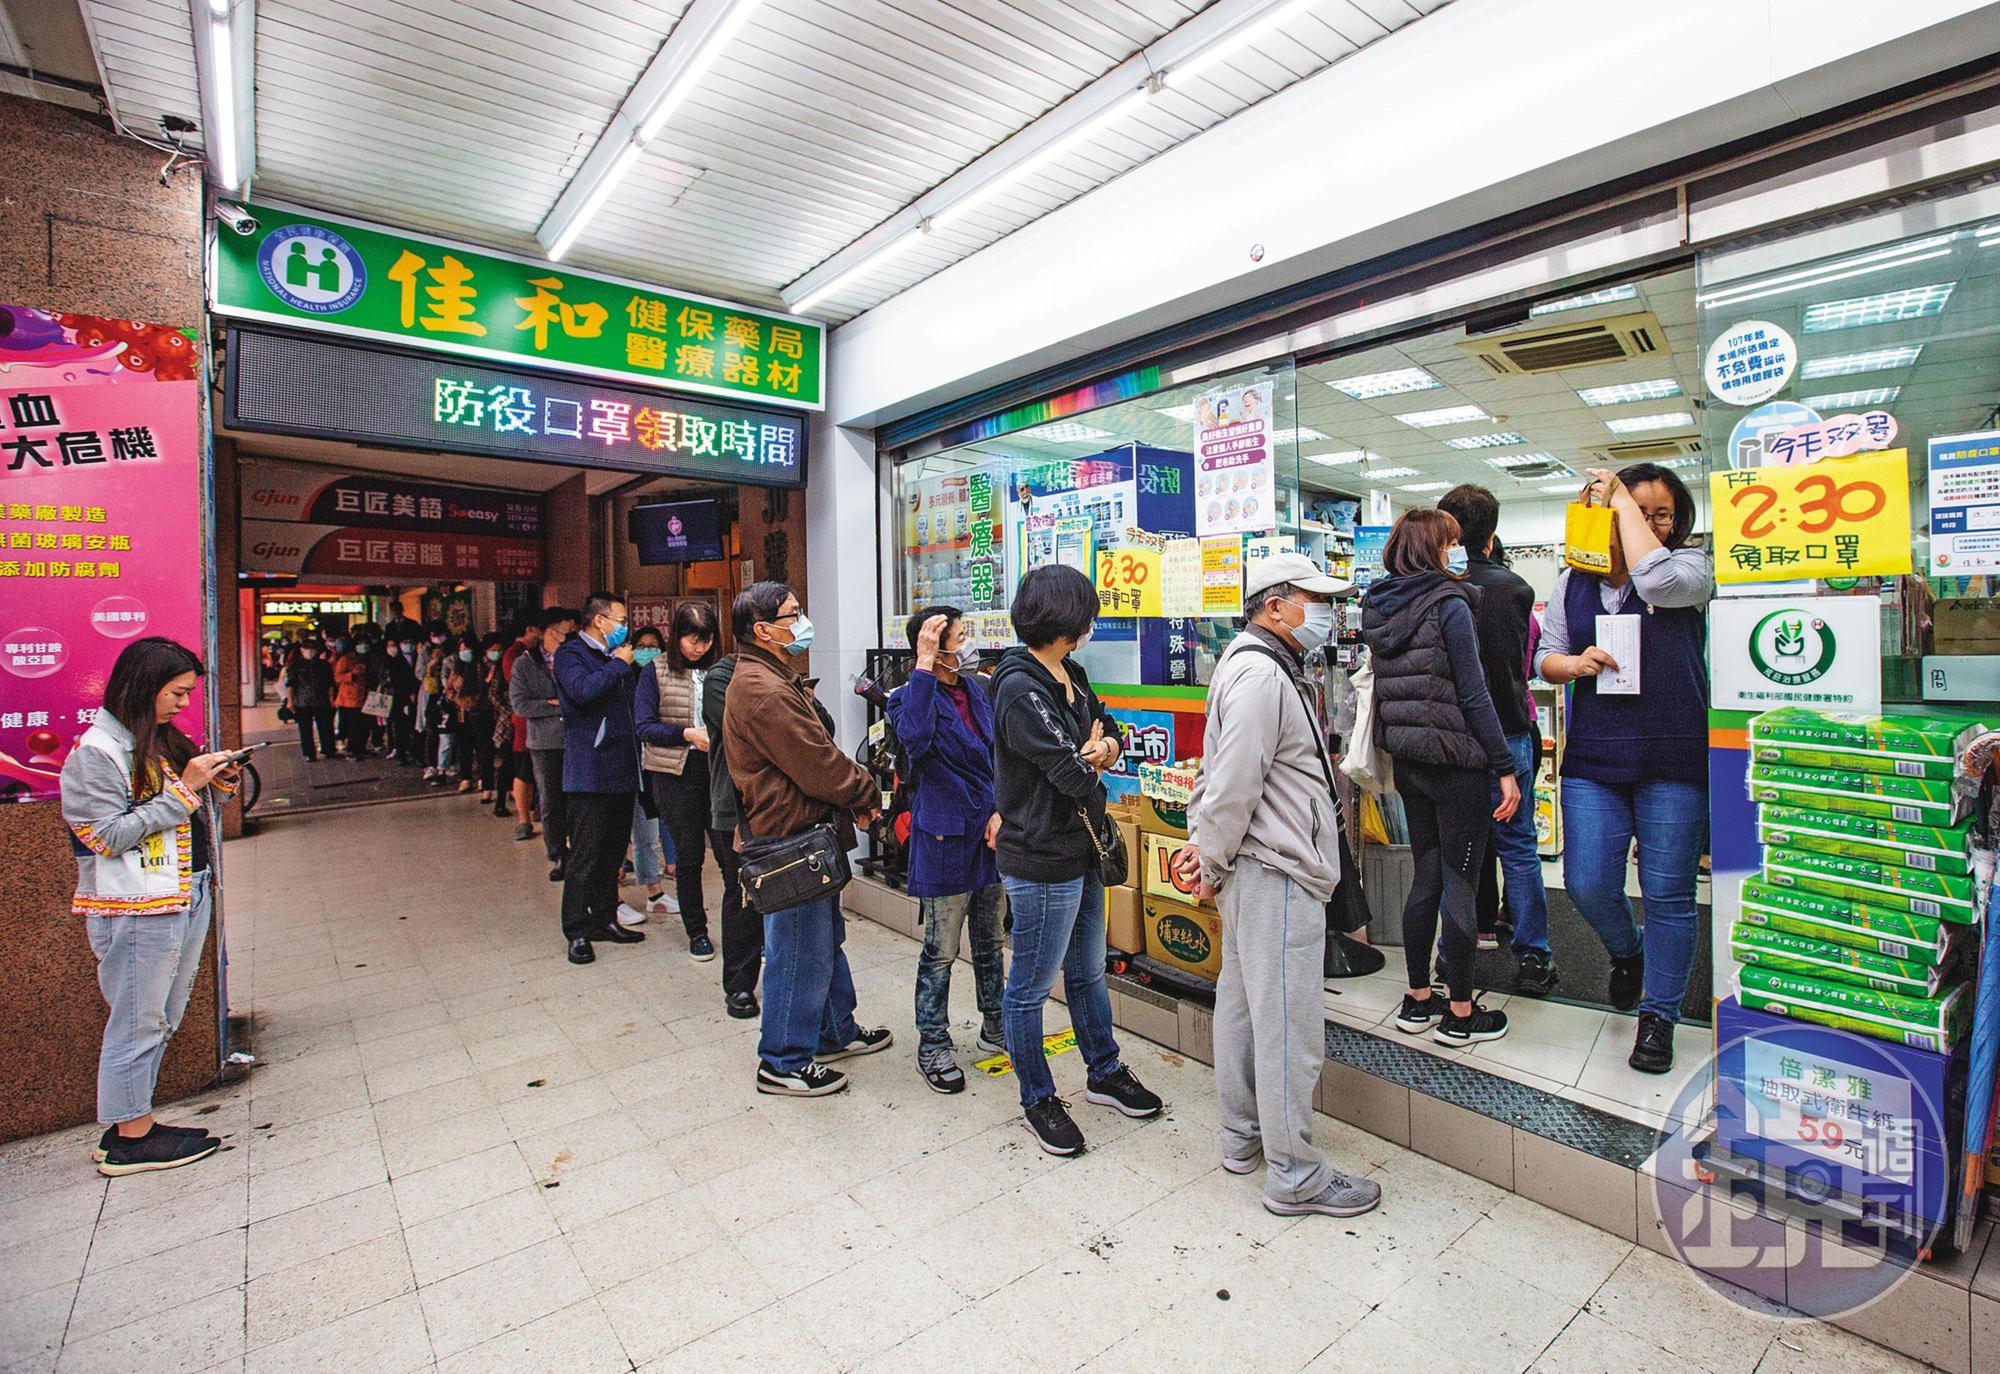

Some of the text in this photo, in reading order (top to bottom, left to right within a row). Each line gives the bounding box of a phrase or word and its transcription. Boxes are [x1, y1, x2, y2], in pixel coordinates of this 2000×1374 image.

[262, 259, 363, 312] NATIONAL HEALTH INSURANCE
[388, 249, 609, 350] 佳和
[625, 295, 803, 359] 健保藥局
[626, 337, 803, 394] 醫療器材
[0, 393, 62, 430] 血
[434, 378, 795, 467] 防役口罩領取時間
[1, 426, 158, 471] 大危機
[252, 488, 300, 507] Gjun
[1723, 471, 1758, 489] 下午
[335, 488, 443, 520] 巨匠美語
[1730, 474, 1887, 539] 2:30
[252, 541, 300, 560] Gjun
[336, 538, 443, 566] 巨匠電腦
[970, 472, 994, 612] 醫療器
[1729, 534, 1860, 571] 領取口罩
[1101, 555, 1148, 588] 2:30
[1738, 691, 1854, 703] 衛生福利部國民健康署特約
[1779, 1056, 1873, 1100] 倍潔雅
[1759, 1076, 1896, 1131] 抽取式衛生紙
